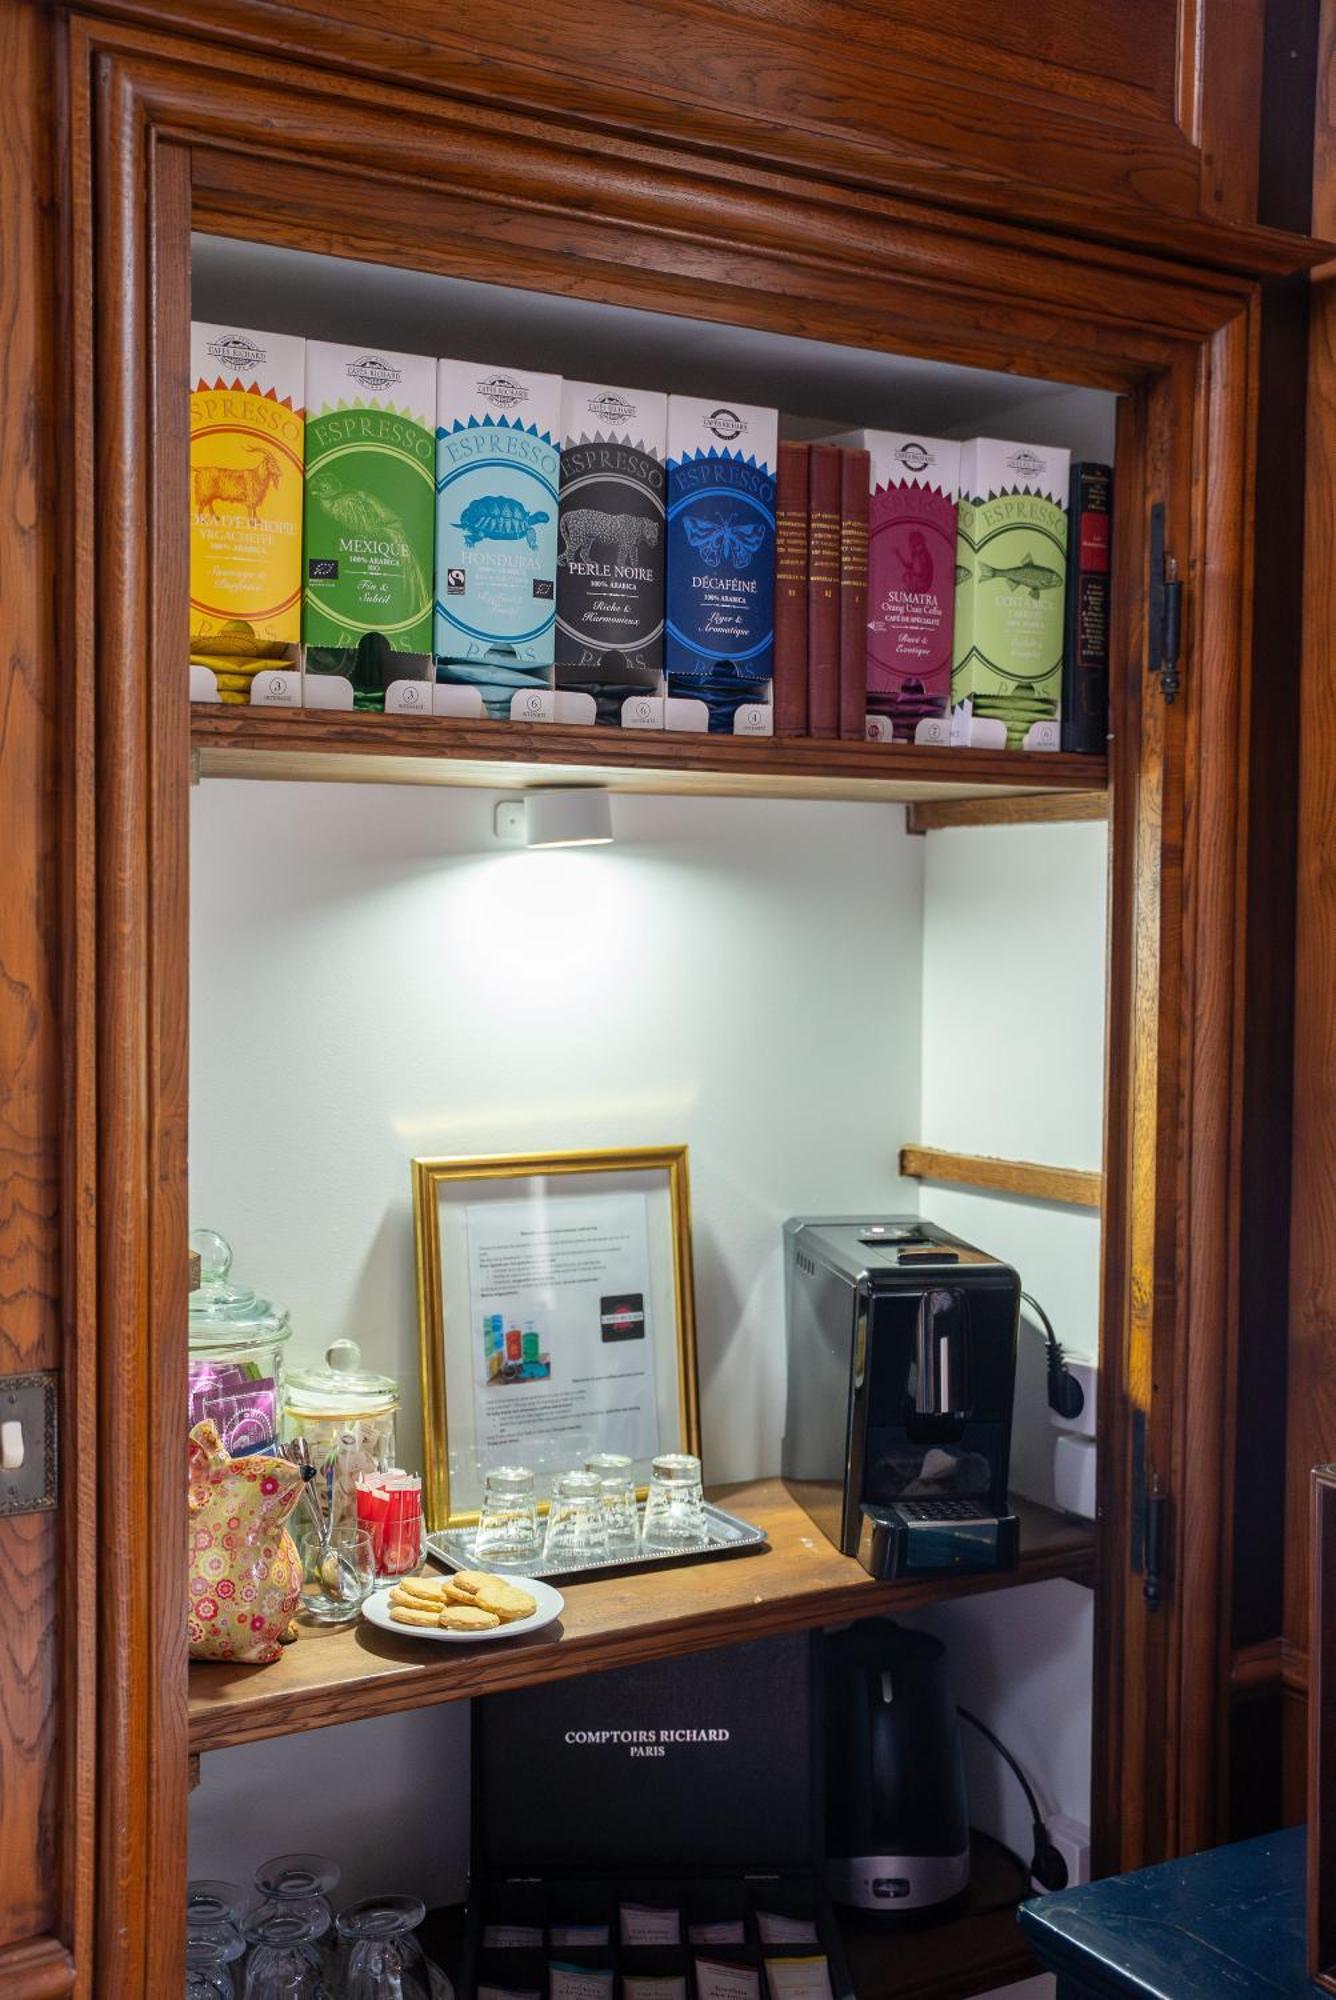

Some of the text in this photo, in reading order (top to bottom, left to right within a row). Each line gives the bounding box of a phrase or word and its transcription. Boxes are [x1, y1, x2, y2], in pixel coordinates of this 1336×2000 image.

[191, 398, 300, 441] SPRESSO
[314, 416, 433, 460] ESPRESSO
[447, 436, 558, 473] ESPRESSO
[561, 450, 664, 488] ESPRESSO
[676, 465, 774, 502] ESPRESSO
[983, 501, 1067, 536] ESPRESSO
[339, 538, 410, 557] MEXIQUE
[369, 557, 400, 567] ARABICA
[461, 549, 544, 570] HONDURAS
[568, 562, 654, 582] PERLE NOIRE
[357, 579, 376, 591] Fin
[609, 581, 637, 591] ARABICA
[692, 575, 758, 593] DÉCAFÉINÉ
[359, 591, 391, 604] Subtil
[720, 595, 746, 604] ARABICA
[888, 590, 938, 606] SUMATRA
[592, 601, 621, 613] Riche
[582, 611, 641, 626] Harmonieux
[698, 623, 750, 638] Aromatique
[565, 1729, 730, 1744] COMPTOIRS RICHARD
[629, 1745, 666, 1757] PARIS
